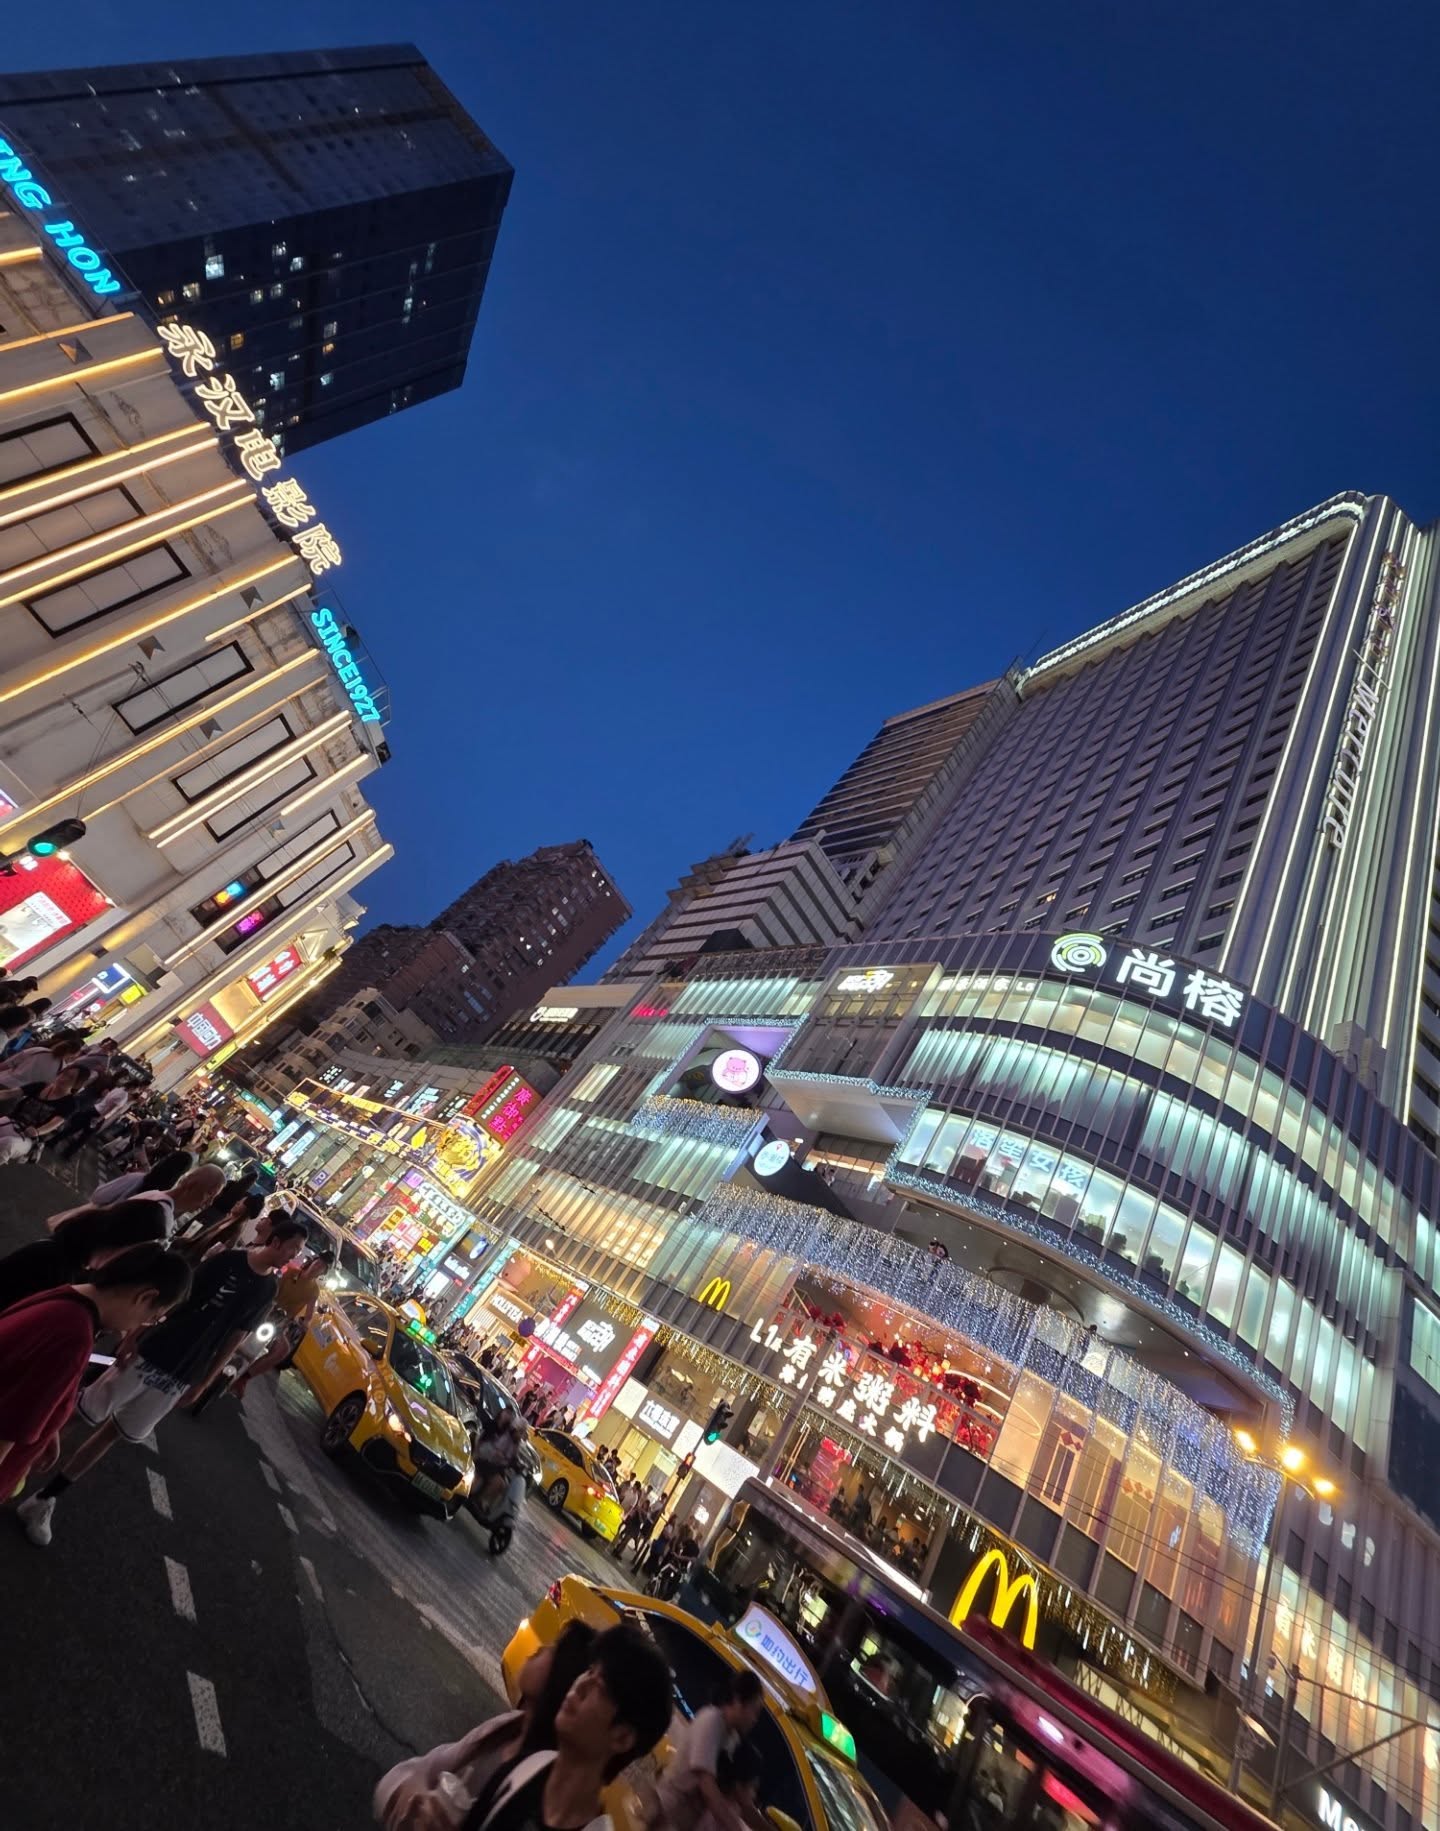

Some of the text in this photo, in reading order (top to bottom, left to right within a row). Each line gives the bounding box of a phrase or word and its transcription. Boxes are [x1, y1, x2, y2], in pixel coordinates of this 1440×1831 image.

[45, 220, 120, 294] HON
[157, 321, 343, 576] 永汉电影院
[1323, 678, 1379, 850] Mercure
[1116, 947, 1245, 1028] 尚榕
[968, 1129, 1089, 1188] 洛笙女孩
